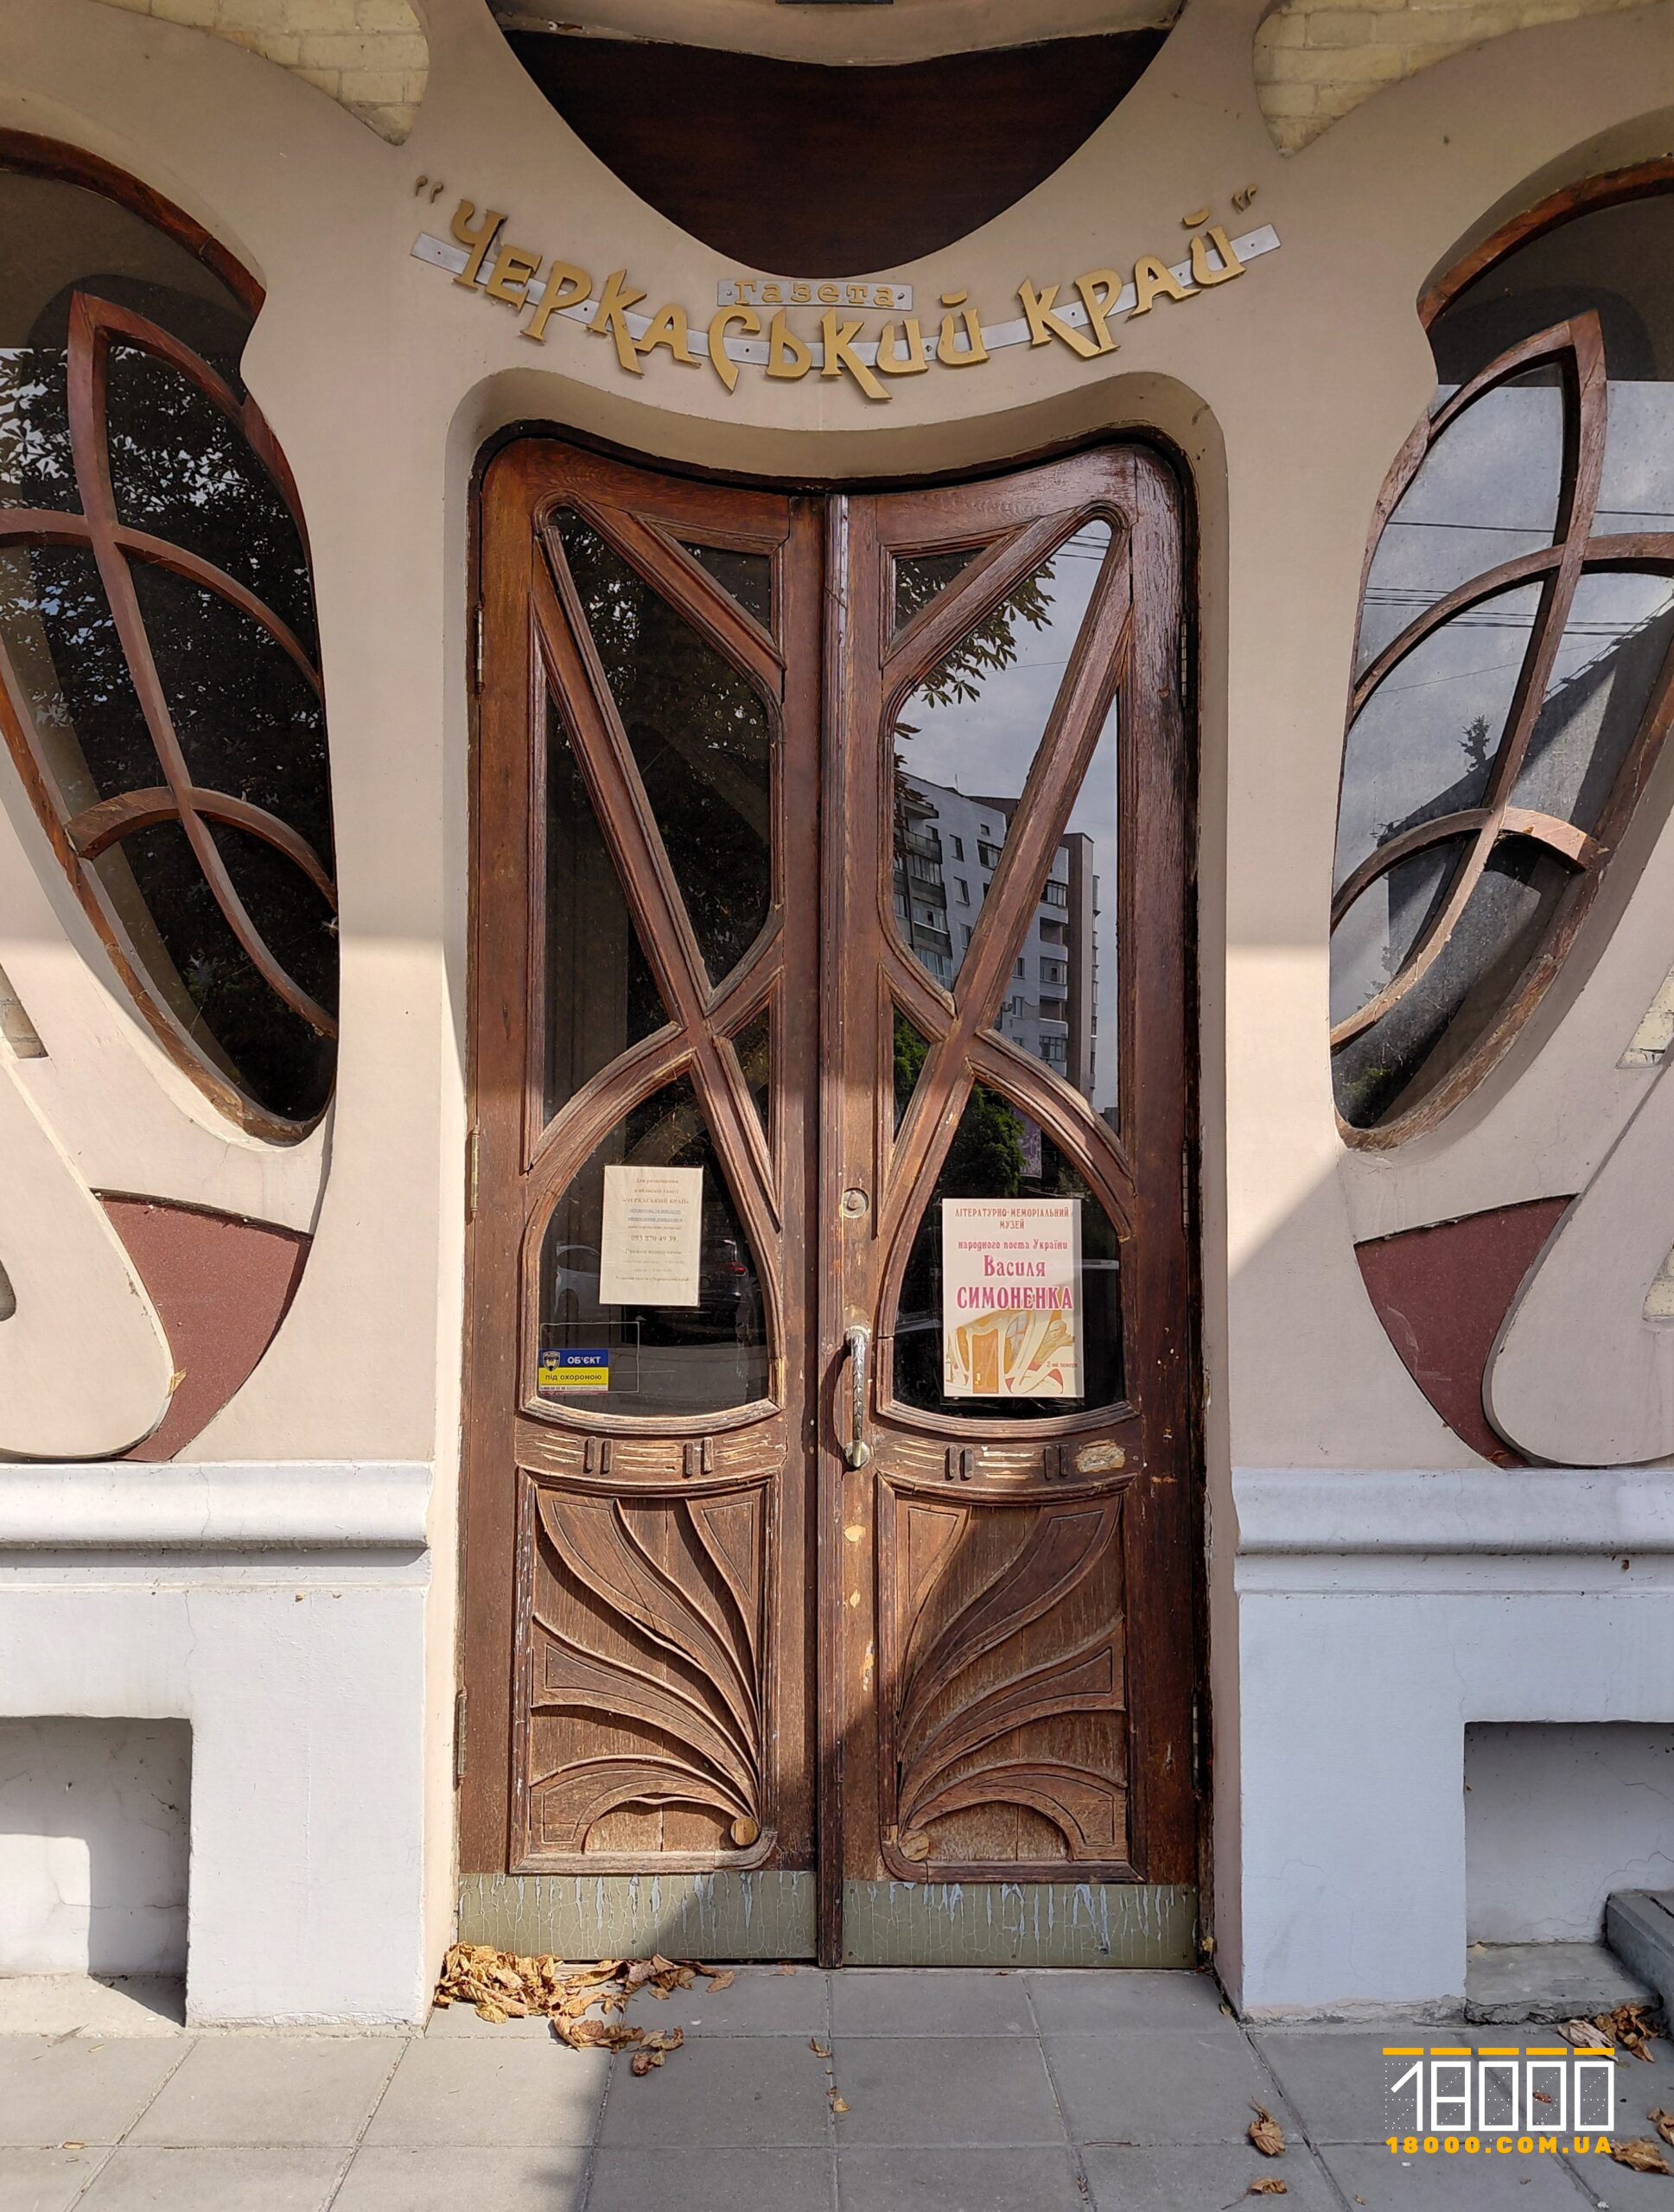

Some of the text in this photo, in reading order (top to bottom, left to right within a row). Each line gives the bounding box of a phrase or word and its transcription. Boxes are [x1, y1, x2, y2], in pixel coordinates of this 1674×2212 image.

[999, 1219, 1025, 1229] МУЗЕЙ
[958, 1238, 1068, 1251] народного поета України
[983, 1255, 1047, 1277] Василя
[957, 1286, 1073, 1309] СИМОНЕНКА
[567, 1356, 602, 1364] ОБ'ЄКТ
